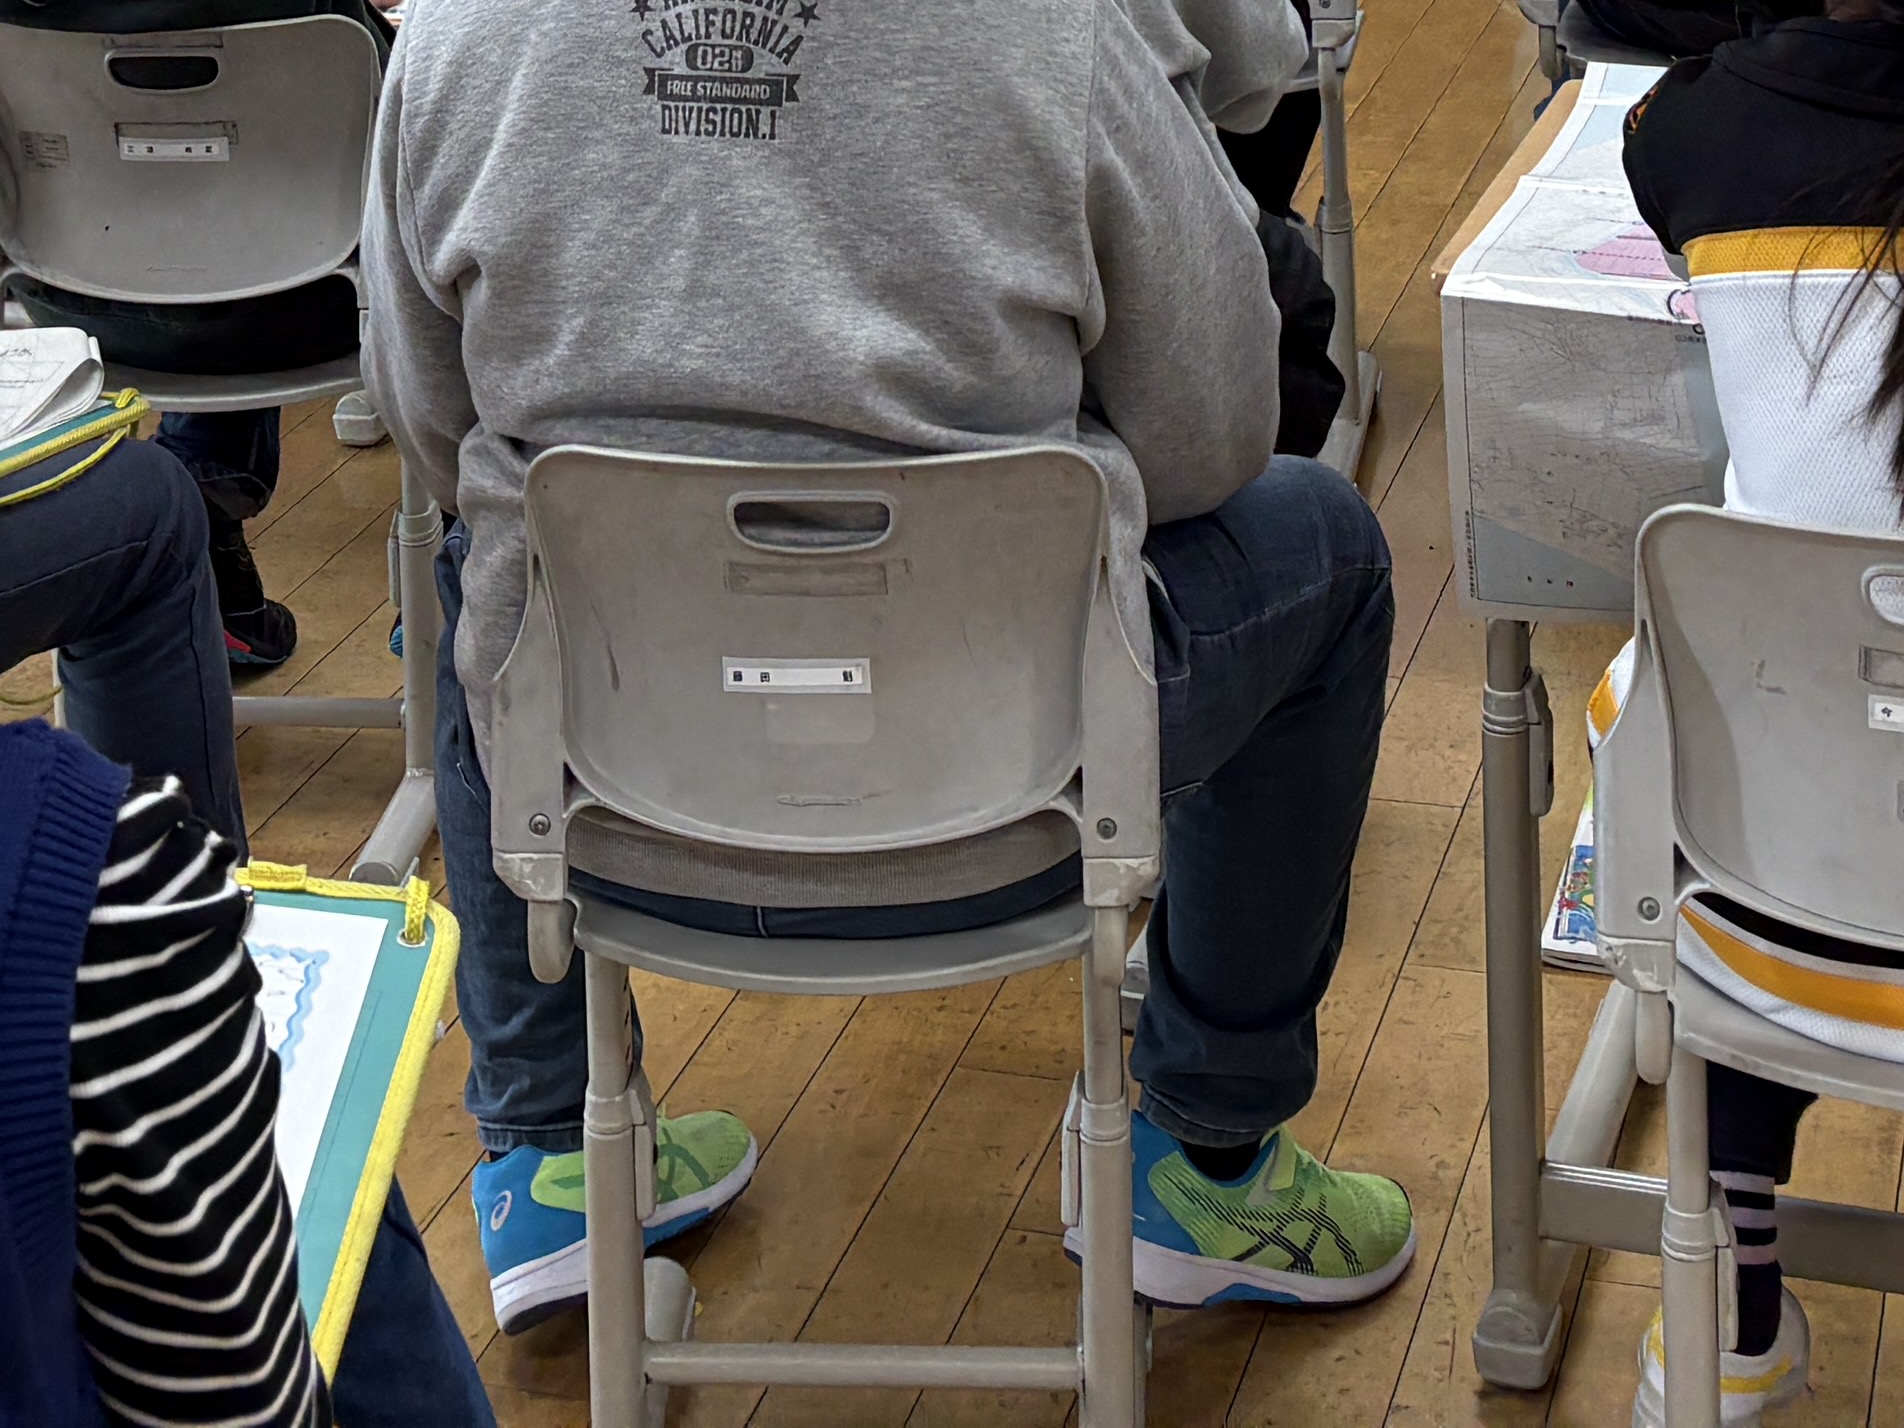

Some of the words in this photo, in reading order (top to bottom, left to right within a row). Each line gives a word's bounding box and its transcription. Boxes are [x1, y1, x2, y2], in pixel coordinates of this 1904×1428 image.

[641, 7, 805, 67] CALIFORNIA
[666, 80, 694, 97] FREE
[697, 81, 771, 100] STANDARD
